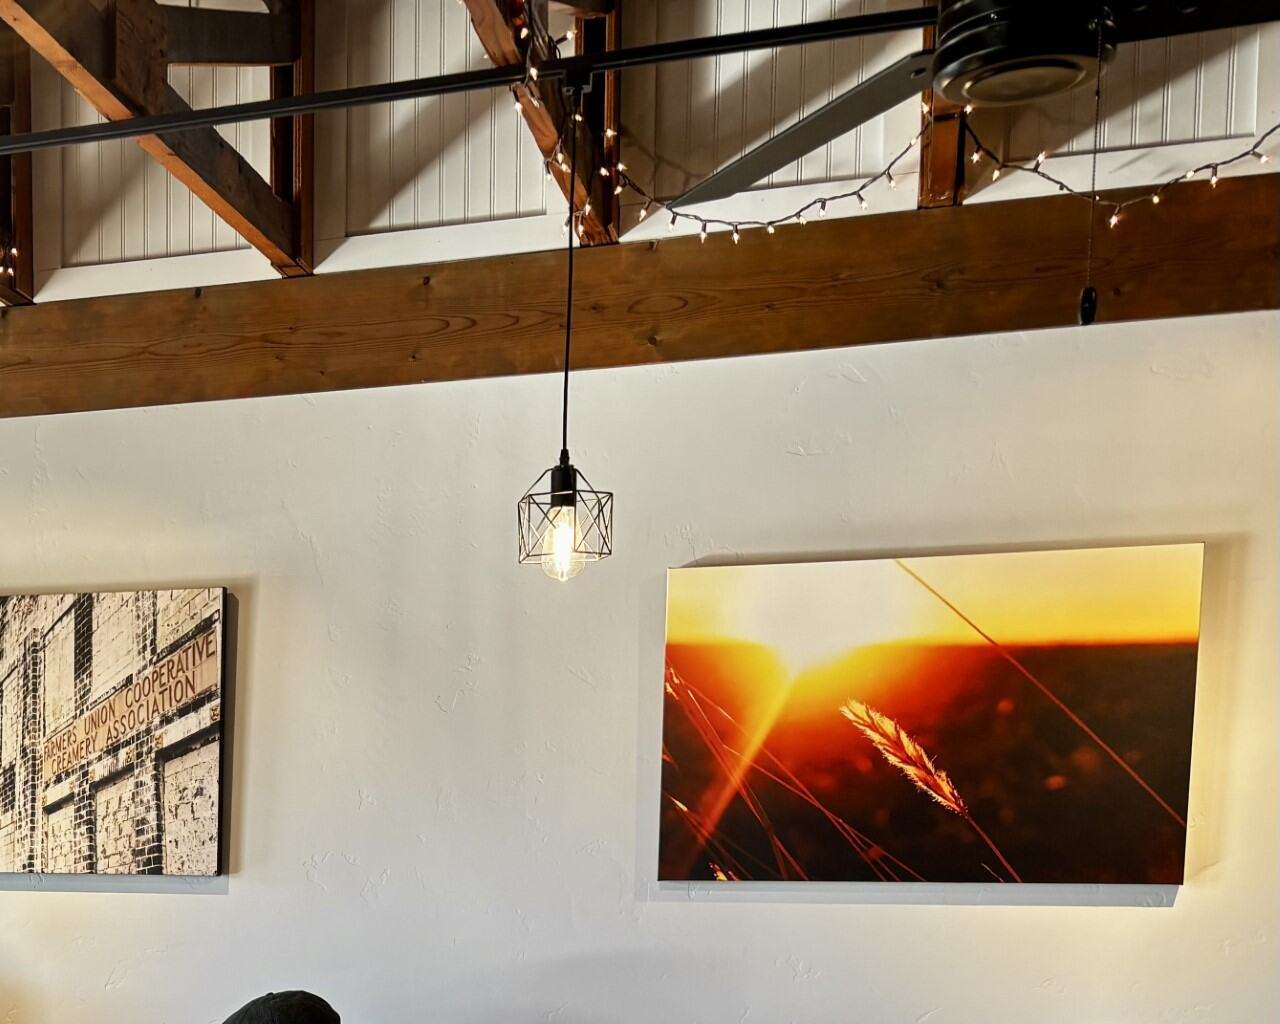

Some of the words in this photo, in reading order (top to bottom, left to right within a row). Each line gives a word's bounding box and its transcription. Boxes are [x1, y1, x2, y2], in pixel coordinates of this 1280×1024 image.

[44, 725, 77, 762] FARMERS
[84, 697, 116, 736] UNION
[125, 629, 216, 709] COOPERATIVE
[51, 731, 98, 775] CREAMERY
[106, 670, 196, 745] ASSOCIATION
